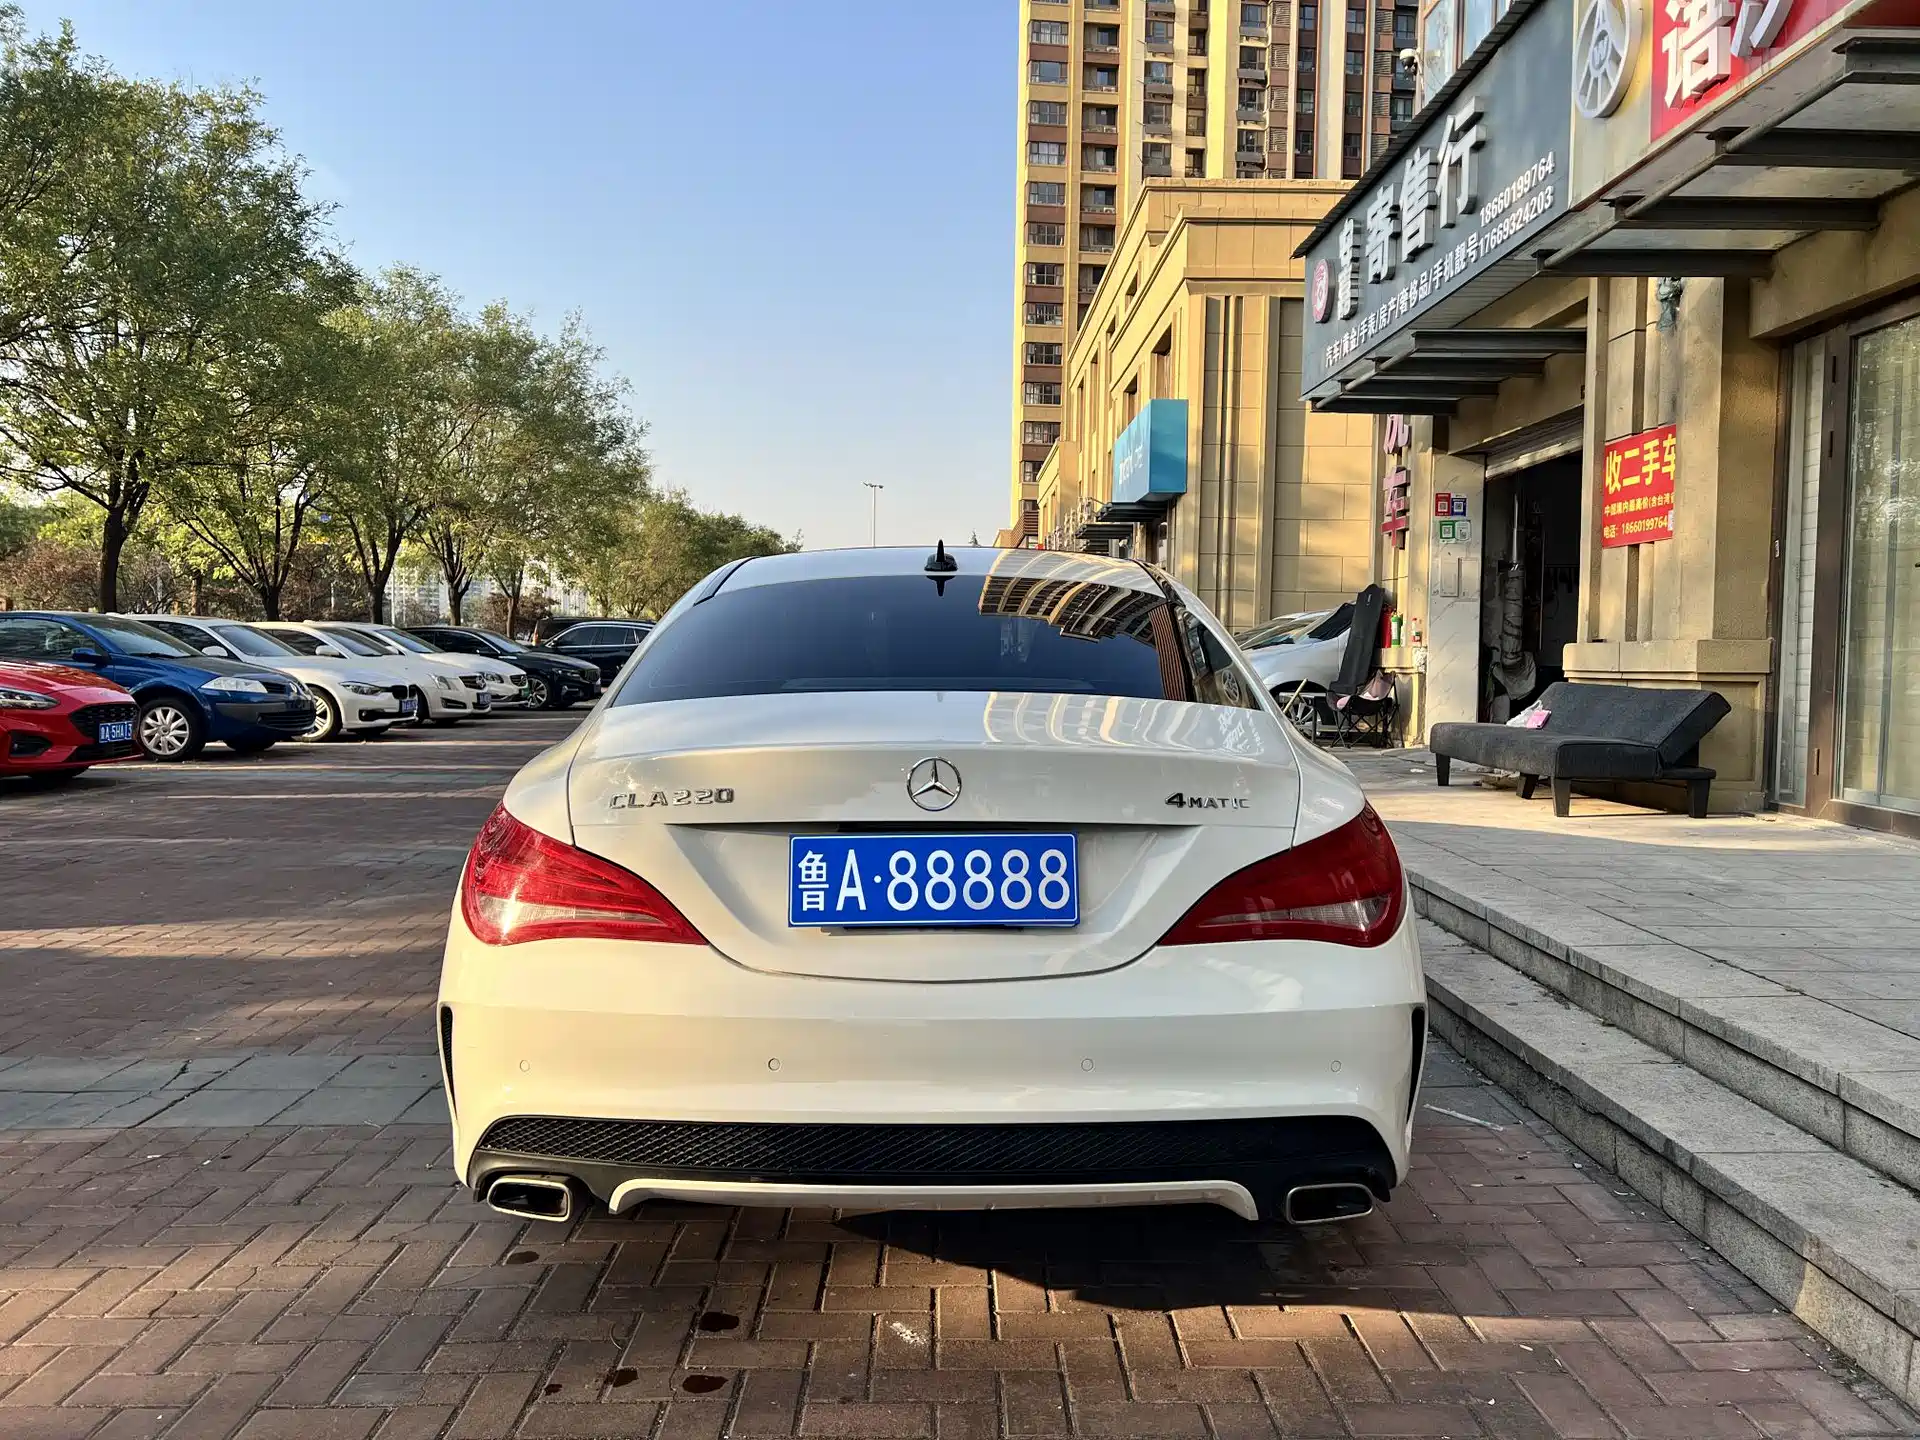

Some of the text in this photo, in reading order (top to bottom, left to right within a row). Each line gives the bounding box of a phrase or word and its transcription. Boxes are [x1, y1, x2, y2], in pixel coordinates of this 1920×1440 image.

[1479, 150, 1555, 228] 18660199764
[1478, 185, 1554, 259] 17669324203
[1605, 433, 1676, 494] 收二手车
[1621, 515, 1668, 535] 18660199764
[1165, 792, 1251, 809] 4MATIC
[798, 848, 1071, 912] 鲁A·88888
